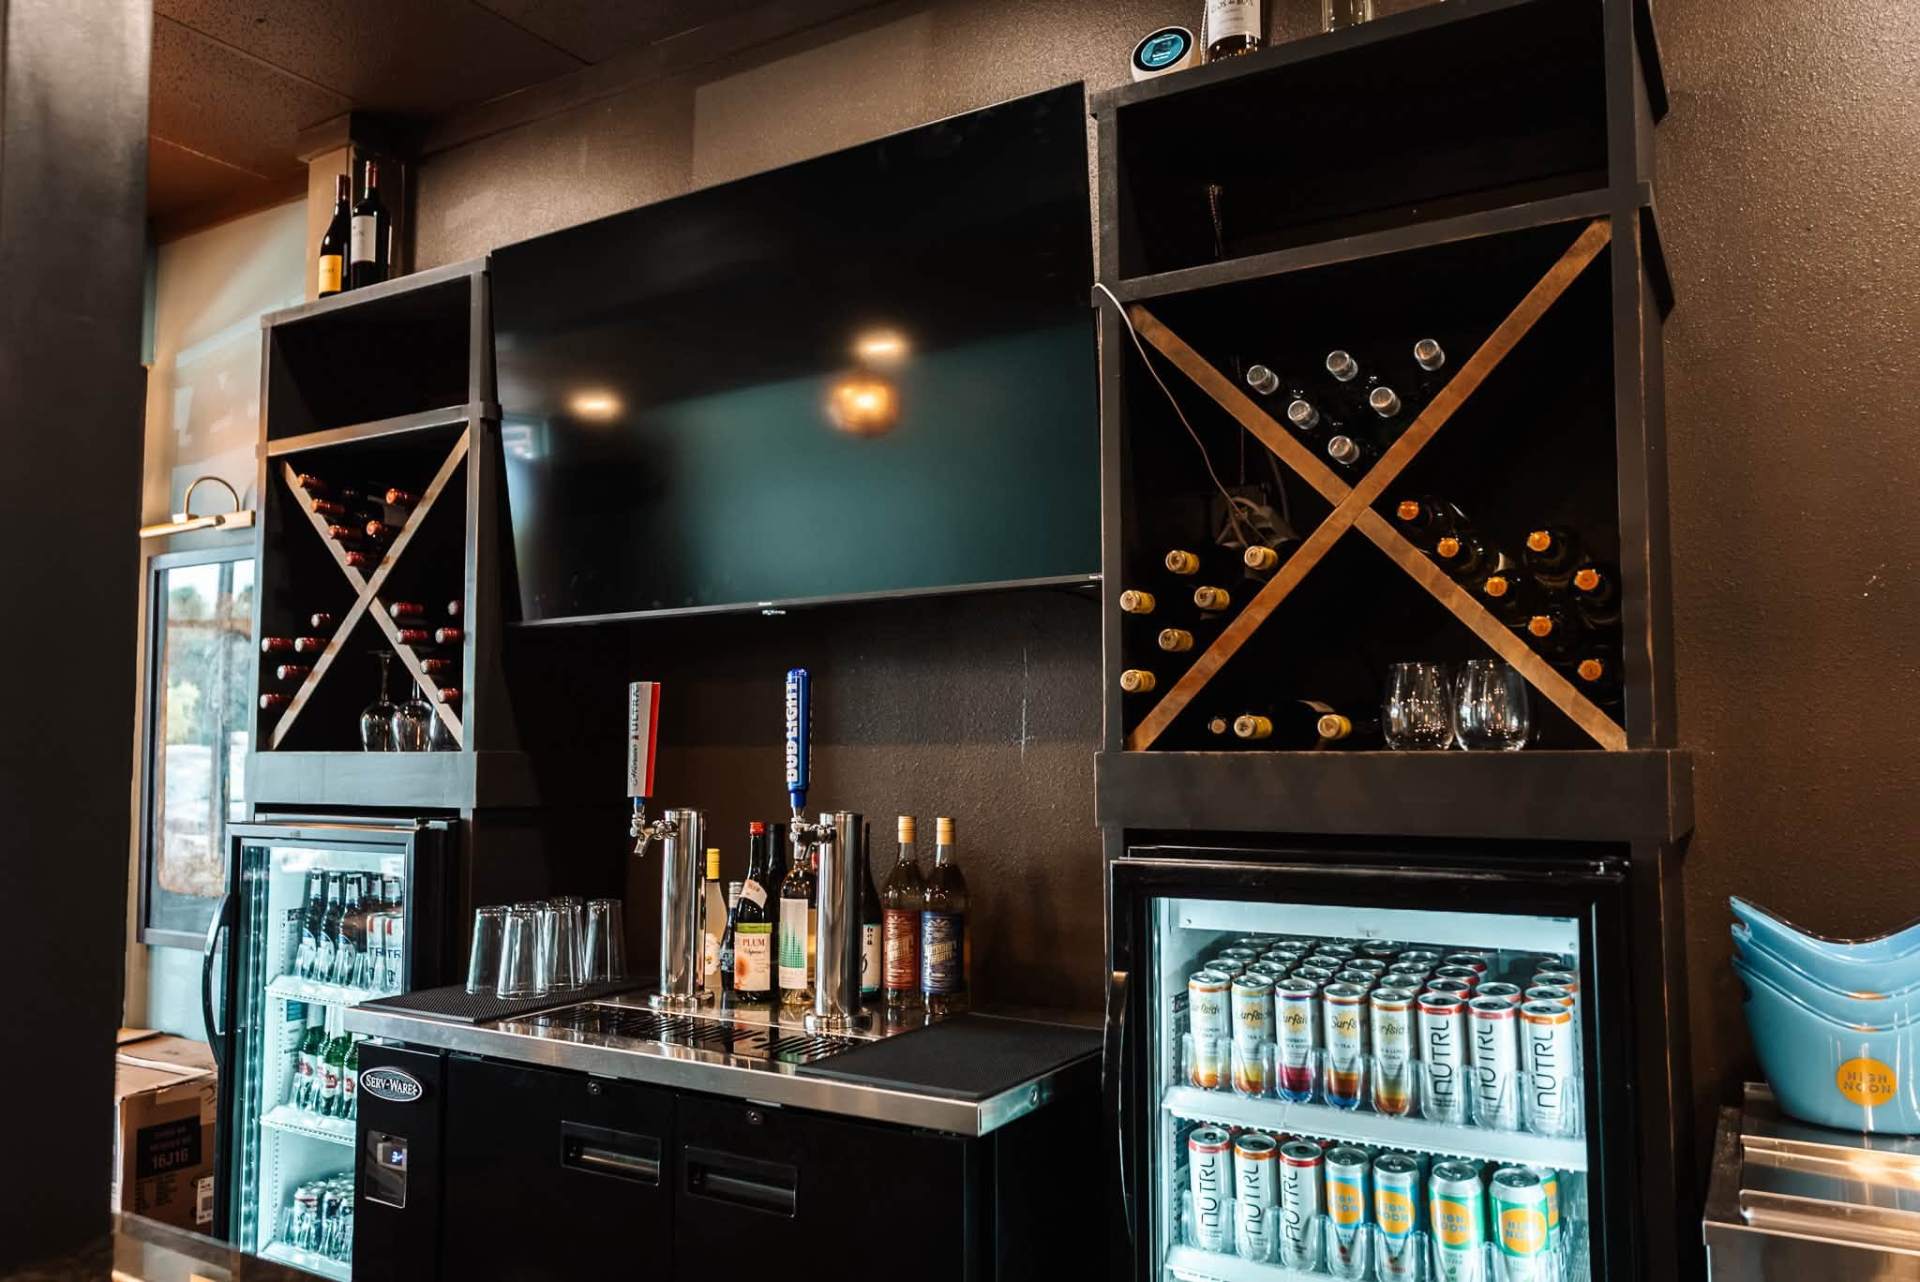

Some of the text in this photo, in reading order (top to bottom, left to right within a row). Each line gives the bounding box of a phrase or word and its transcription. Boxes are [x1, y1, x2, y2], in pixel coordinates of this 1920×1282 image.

[631, 684, 639, 732] ULTRA
[786, 682, 798, 782] BUD LIGHT
[742, 938, 765, 946] PLUM
[1847, 1072, 1887, 1083] HIGH
[1843, 1081, 1891, 1094] NOON
